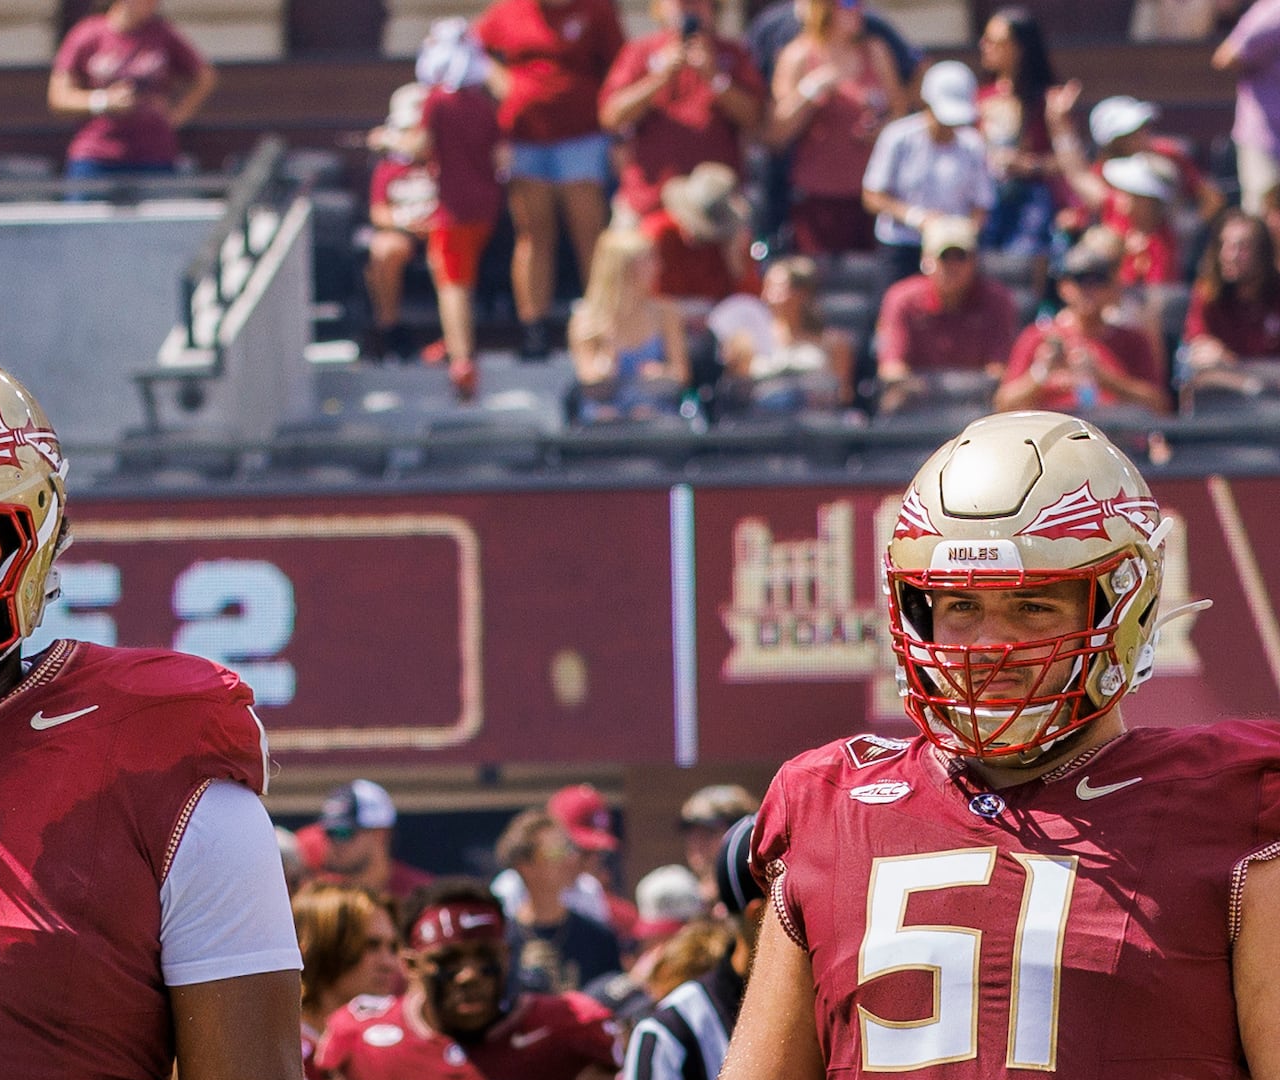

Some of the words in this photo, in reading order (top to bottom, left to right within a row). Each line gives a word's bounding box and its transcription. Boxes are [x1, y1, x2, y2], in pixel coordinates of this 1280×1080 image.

[948, 547, 999, 561] NOLES
[173, 558, 298, 706] 2
[858, 783, 907, 796] ACC
[856, 846, 1080, 1072] 51
